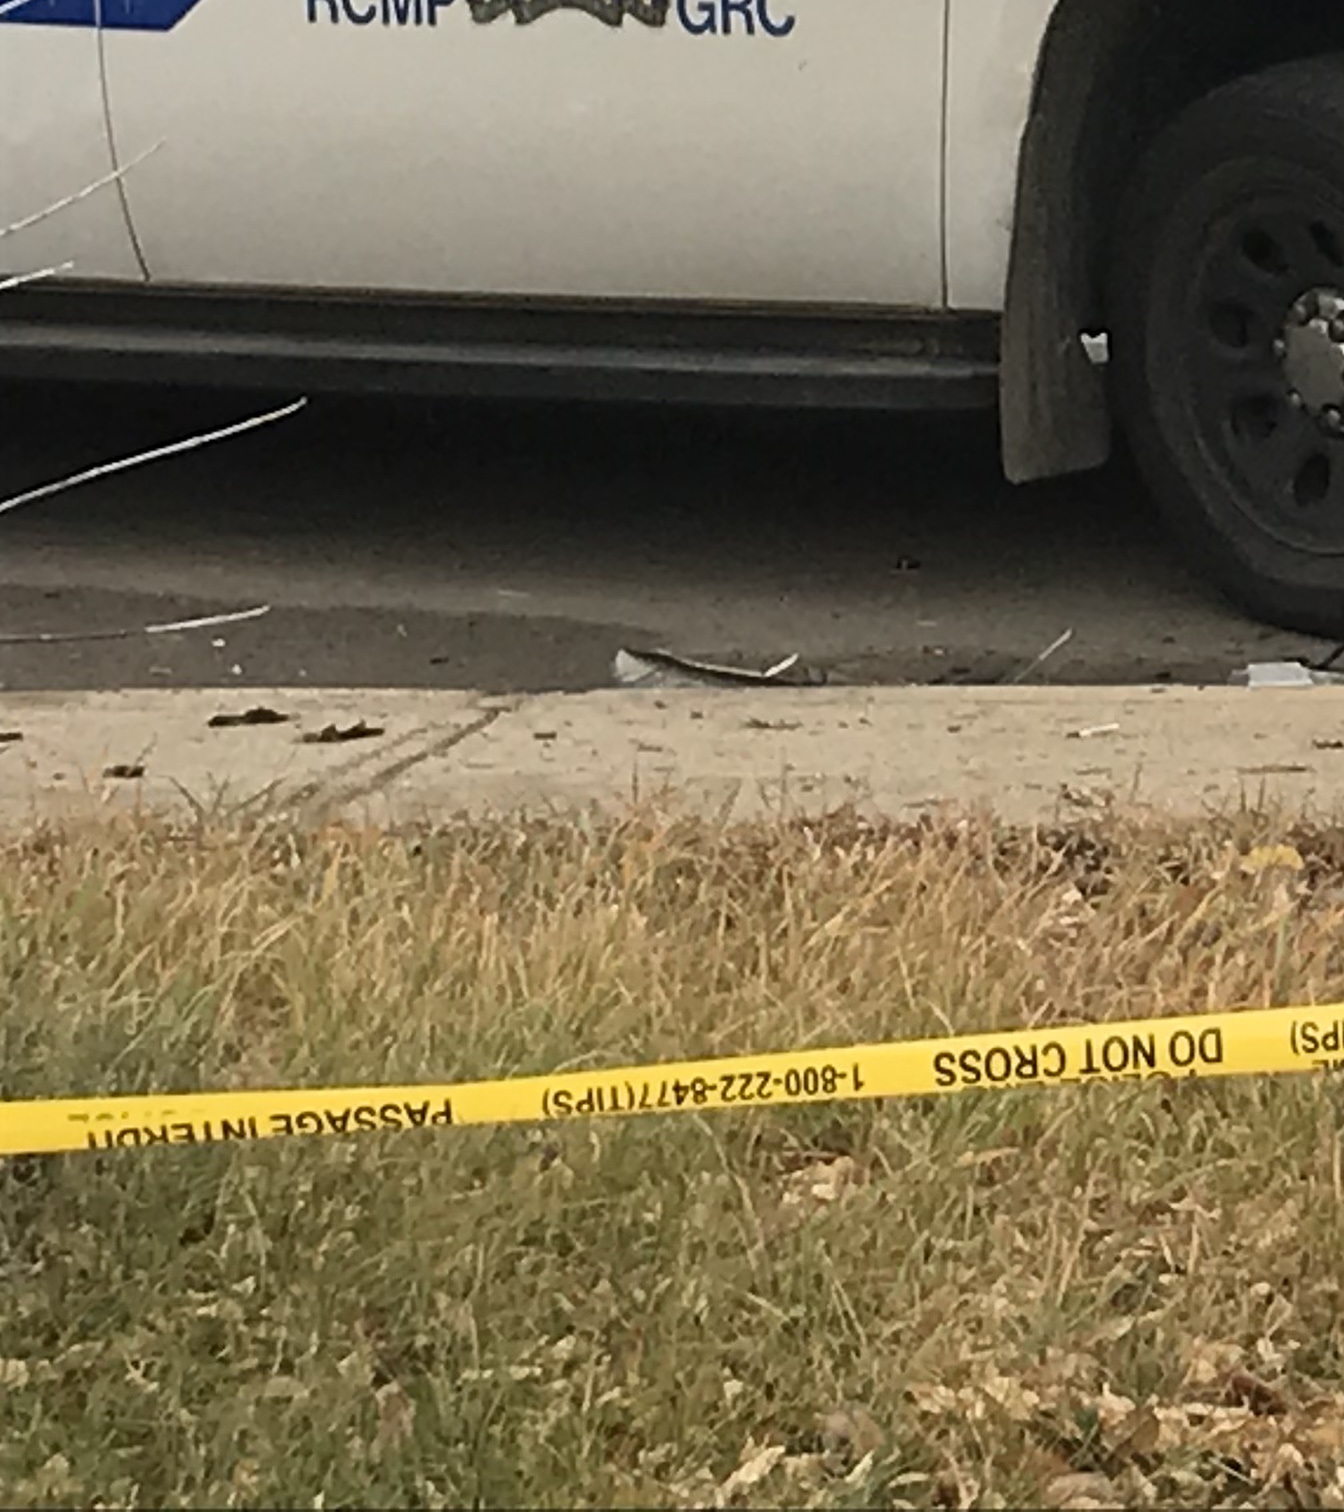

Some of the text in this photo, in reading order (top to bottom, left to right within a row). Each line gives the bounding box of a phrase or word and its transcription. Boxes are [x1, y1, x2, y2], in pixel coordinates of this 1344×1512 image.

[933, 1044, 1065, 1086] CROSS
[1078, 1035, 1155, 1075] NOT
[1168, 1027, 1222, 1066] DO
[542, 1062, 865, 1117] 1-800-222-8477(TIPS)
[271, 1098, 453, 1136] PASSAGE
